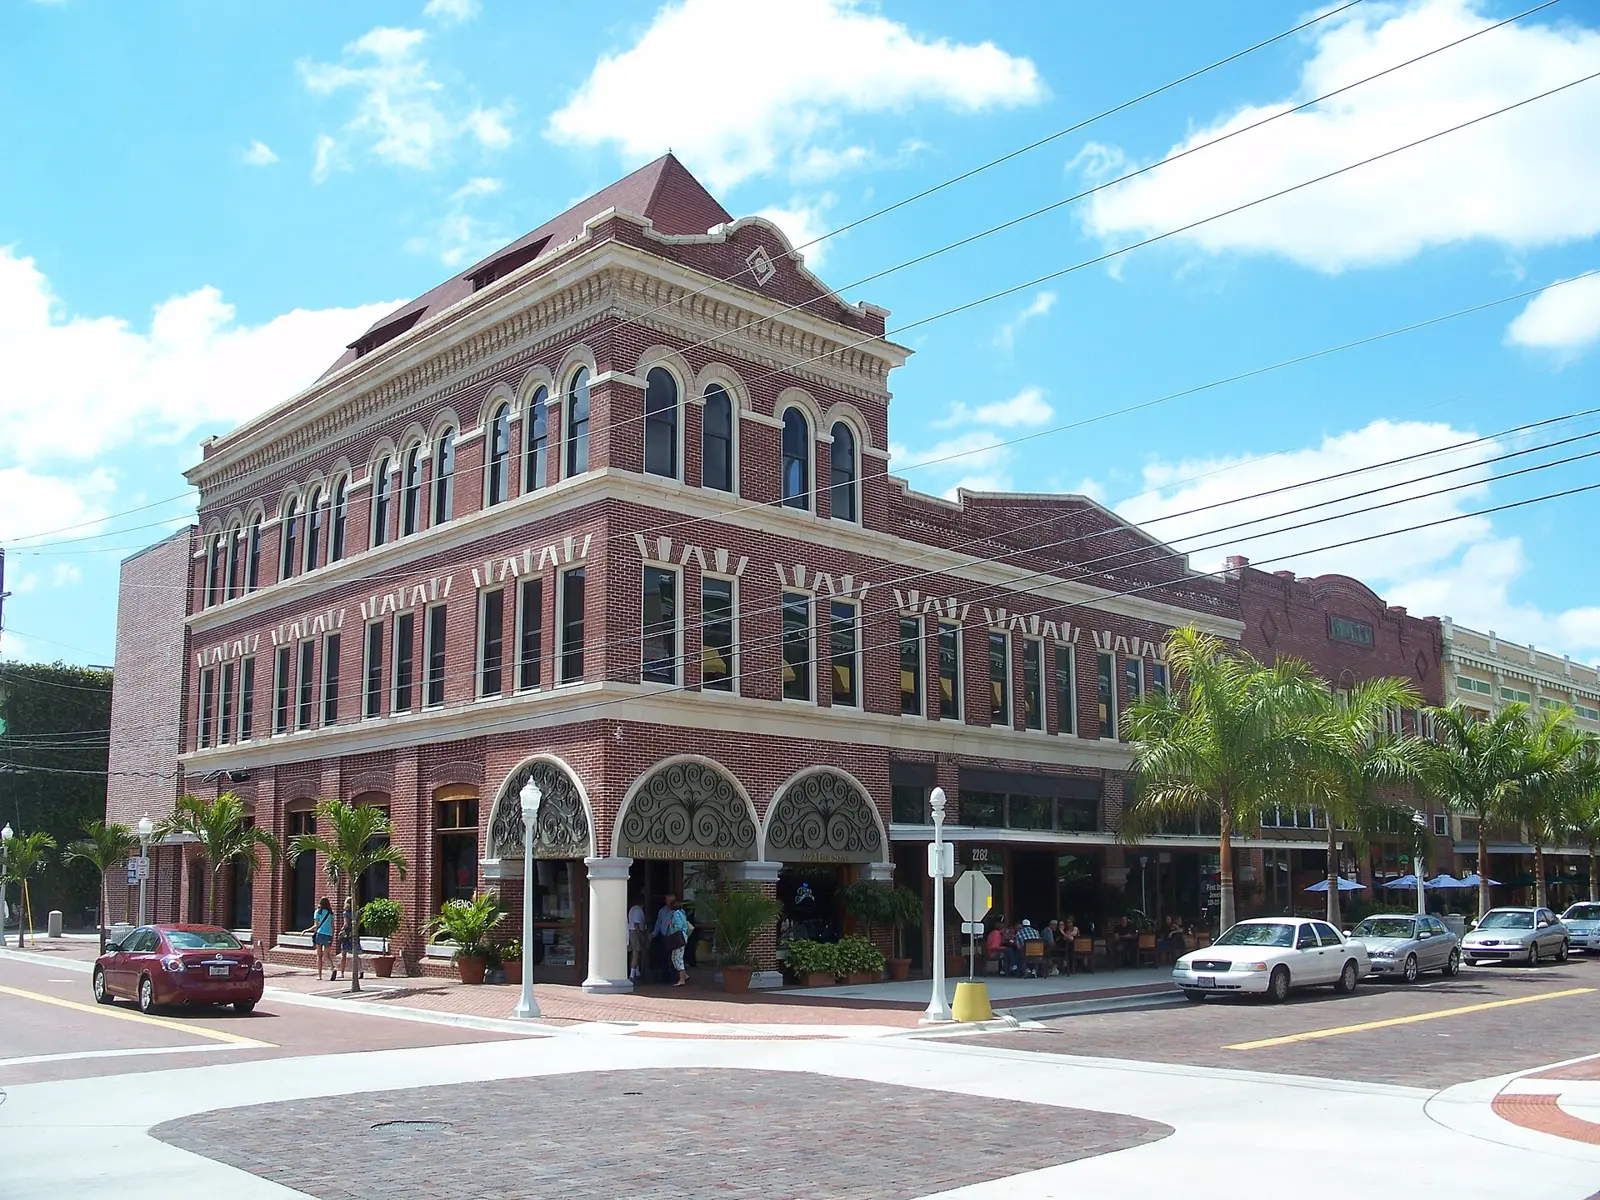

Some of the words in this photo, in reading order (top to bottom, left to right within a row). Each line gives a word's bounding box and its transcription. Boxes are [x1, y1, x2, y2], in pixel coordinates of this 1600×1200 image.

[626, 844, 645, 858] The
[647, 844, 679, 859] French
[973, 849, 987, 860] 2282
